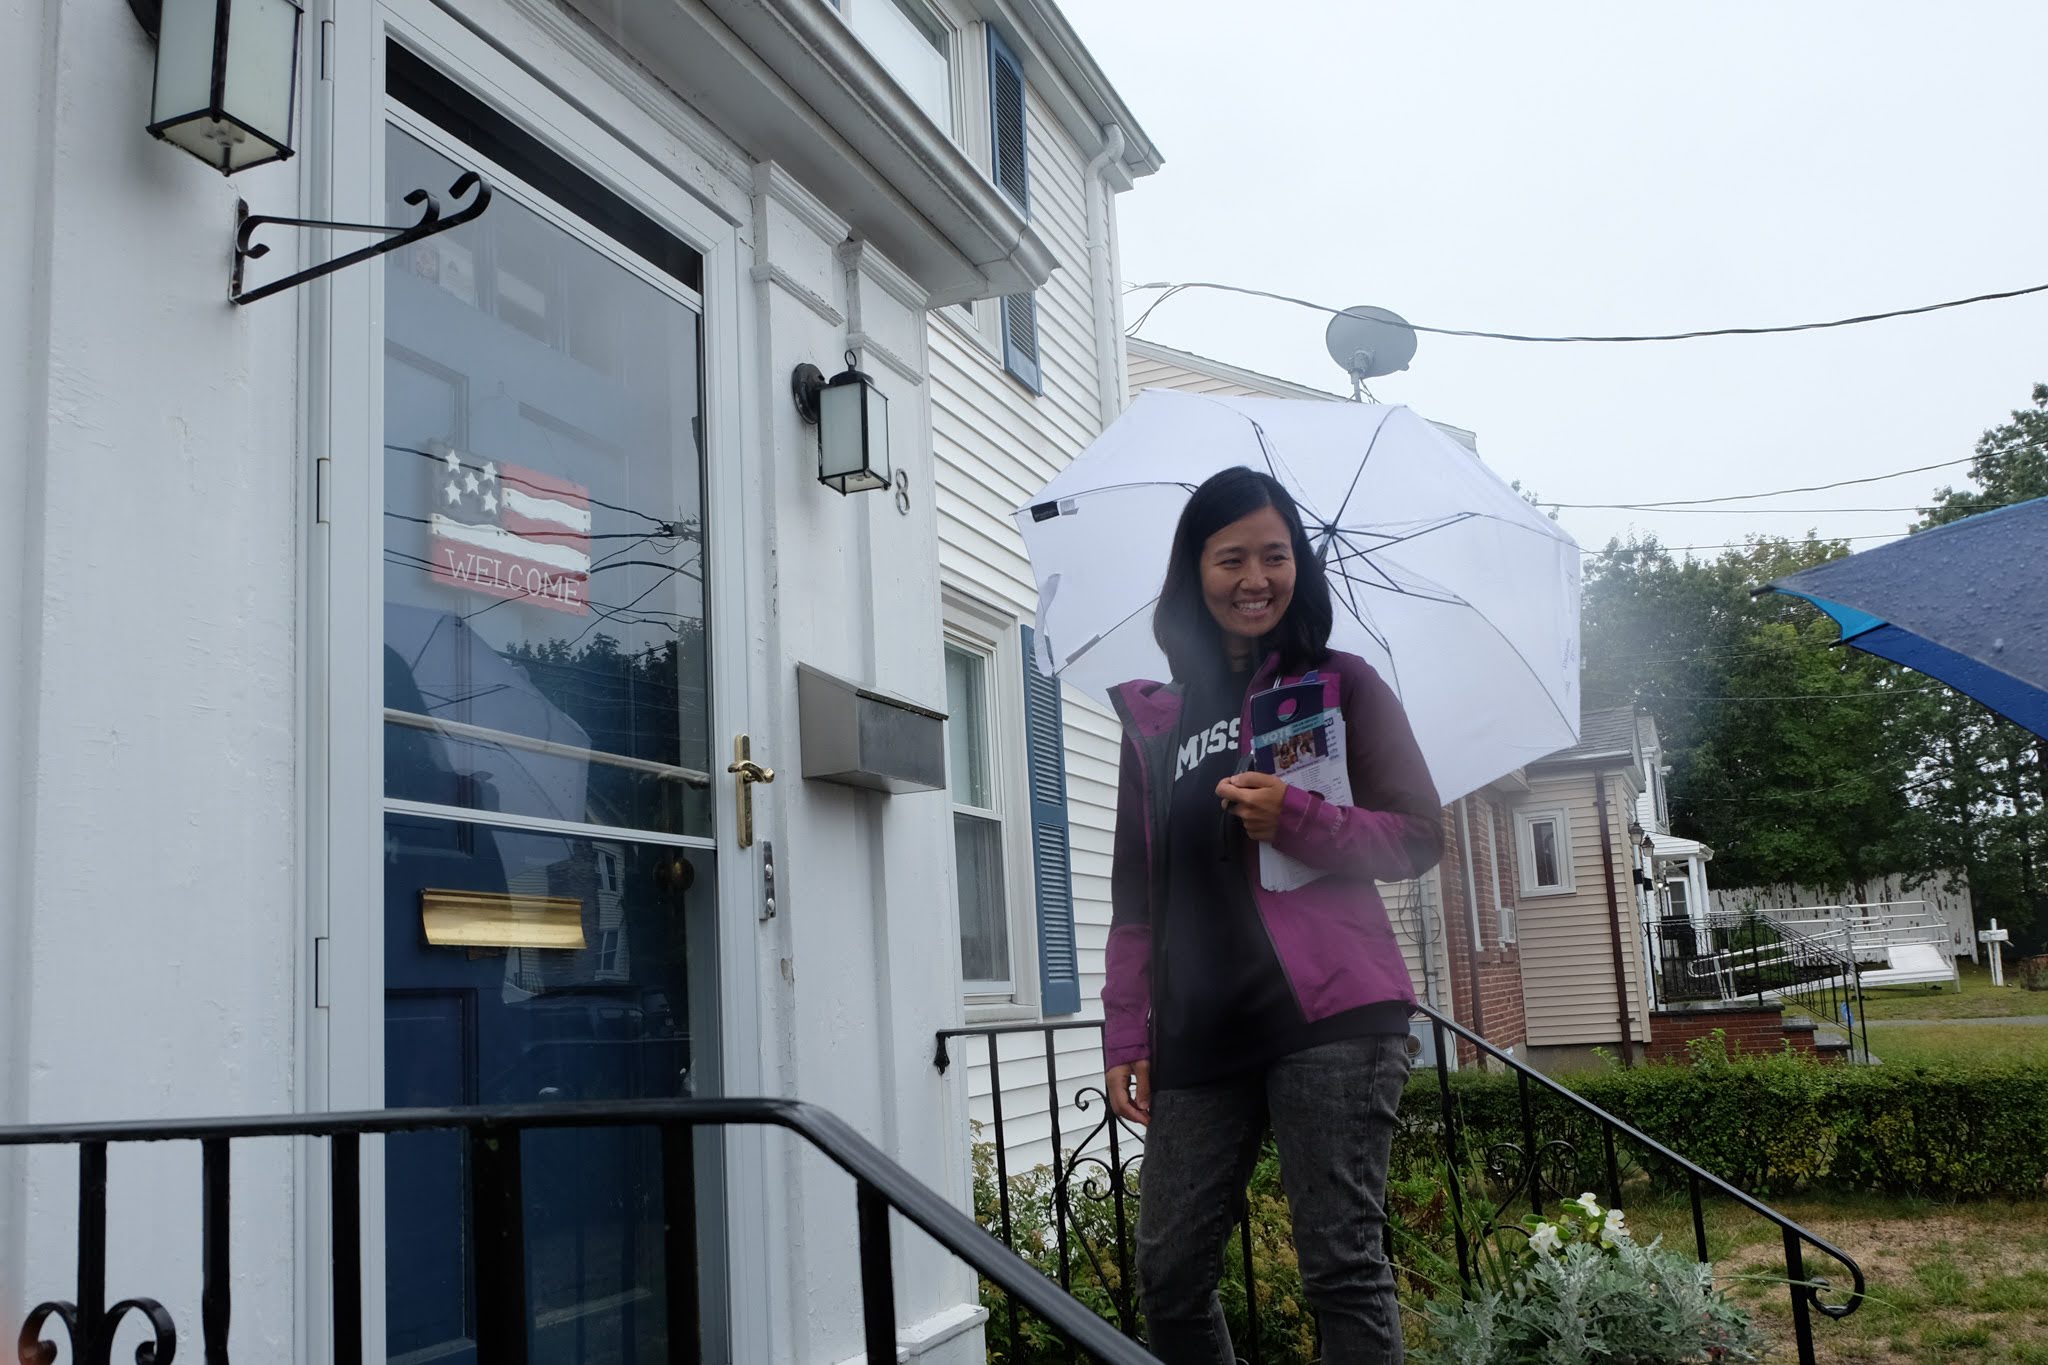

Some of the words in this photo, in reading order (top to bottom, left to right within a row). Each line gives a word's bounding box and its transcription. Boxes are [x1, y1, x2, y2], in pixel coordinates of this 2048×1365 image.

[895, 467, 910, 516] 8
[445, 548, 583, 607] WELCOME
[1261, 727, 1293, 745] VOTE
